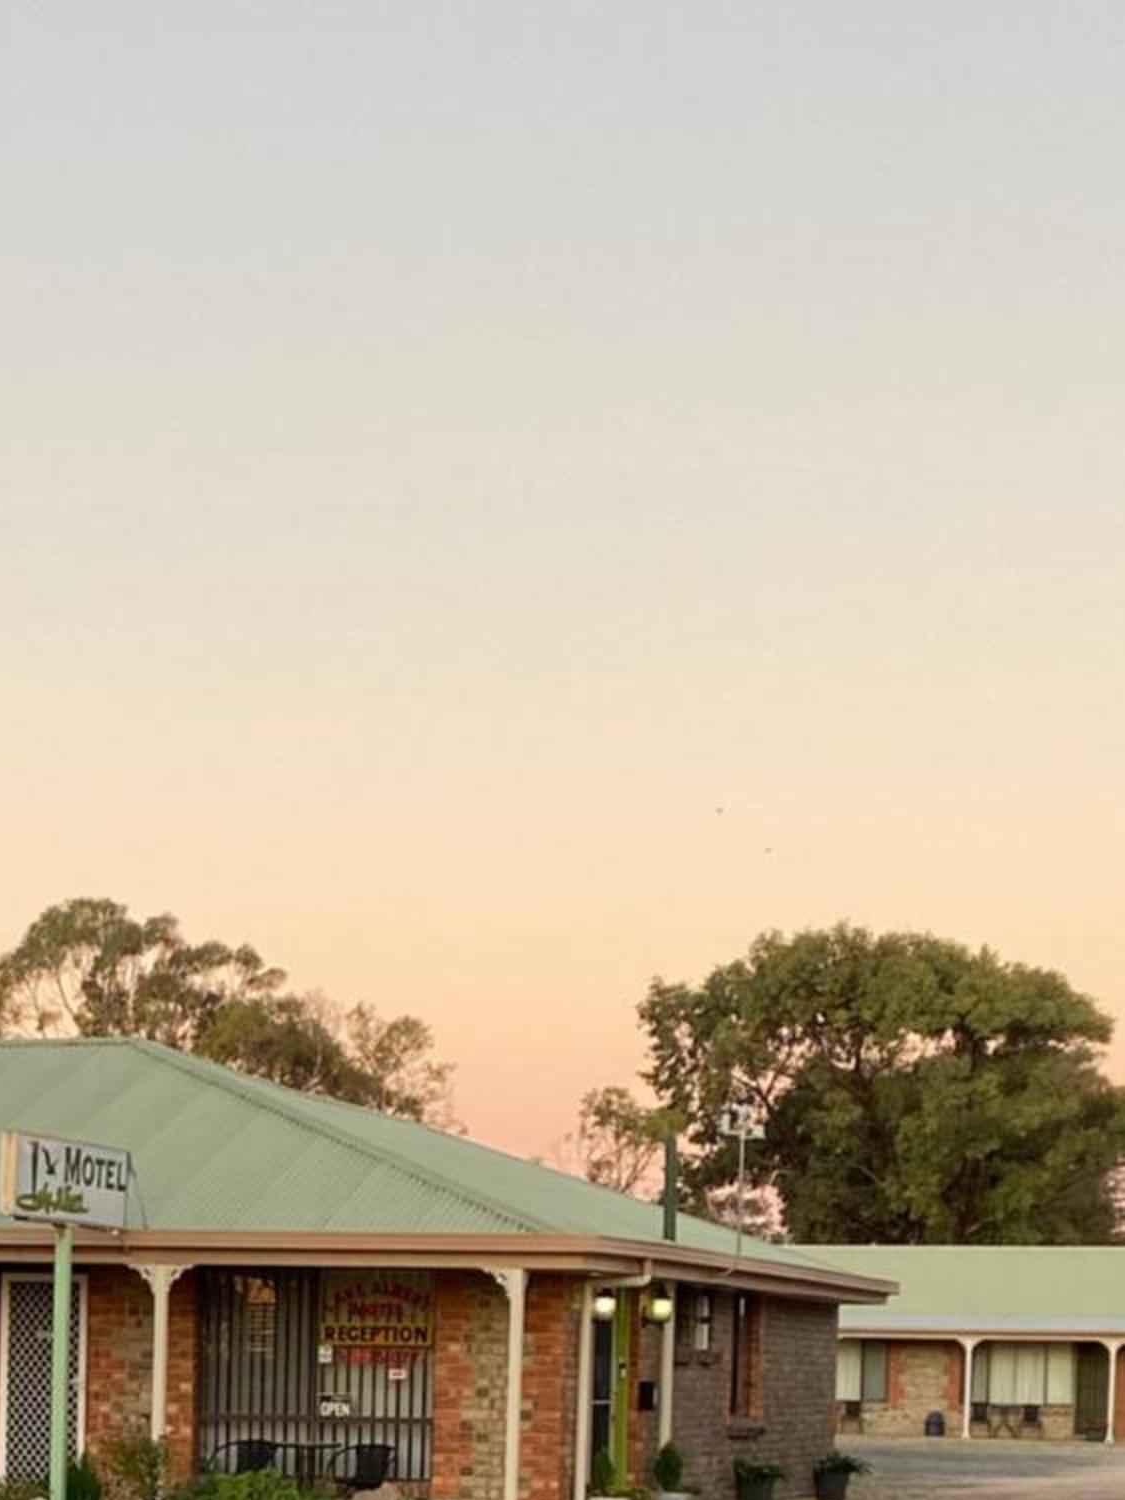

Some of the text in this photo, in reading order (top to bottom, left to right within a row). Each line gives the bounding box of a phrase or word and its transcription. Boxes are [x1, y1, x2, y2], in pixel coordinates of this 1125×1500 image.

[65, 1147, 127, 1191] MOTEL
[324, 1326, 428, 1343] RECEPTION
[320, 1402, 350, 1417] OPEN
